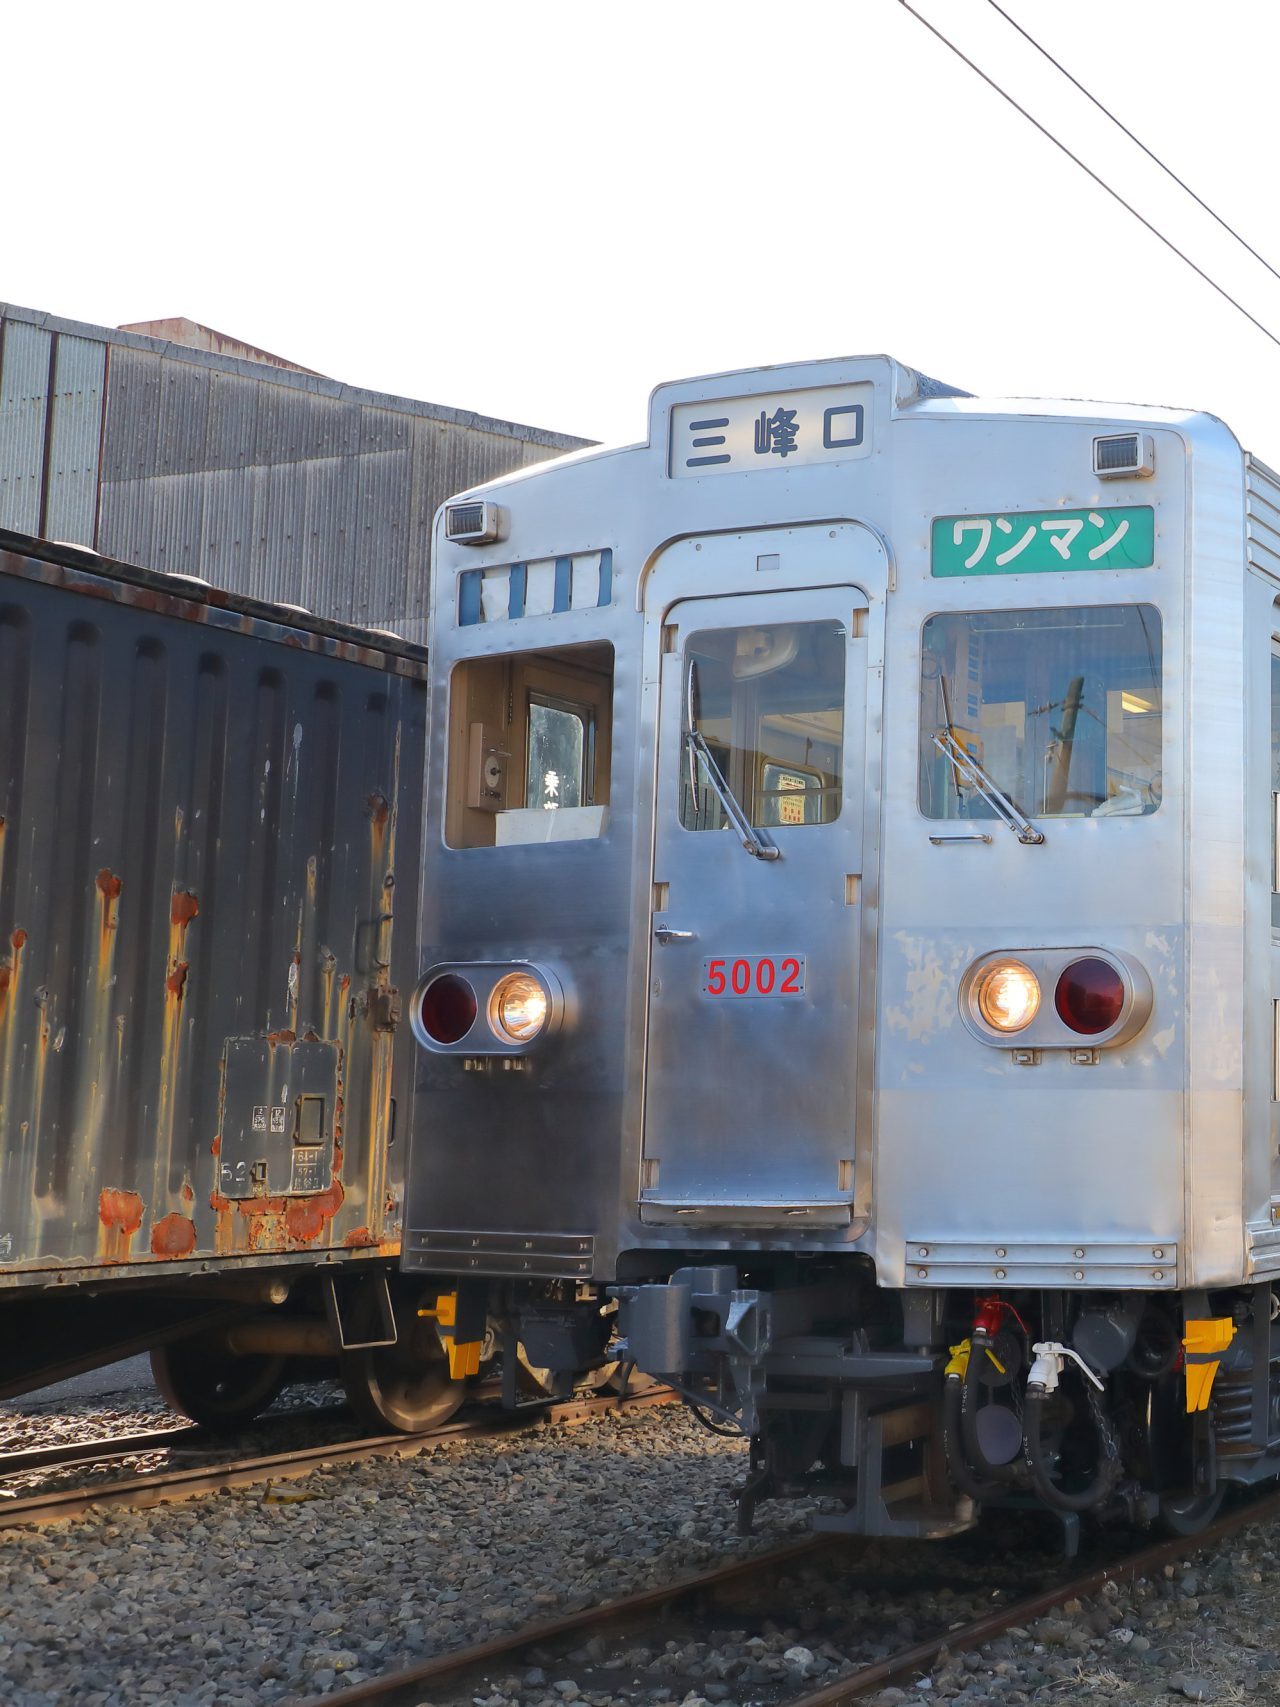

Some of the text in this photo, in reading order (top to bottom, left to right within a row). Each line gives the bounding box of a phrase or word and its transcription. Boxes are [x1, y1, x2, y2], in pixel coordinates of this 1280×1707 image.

[686, 404, 864, 468] 三峰口
[953, 512, 1129, 569] ワンマン
[707, 958, 800, 995] 5002
